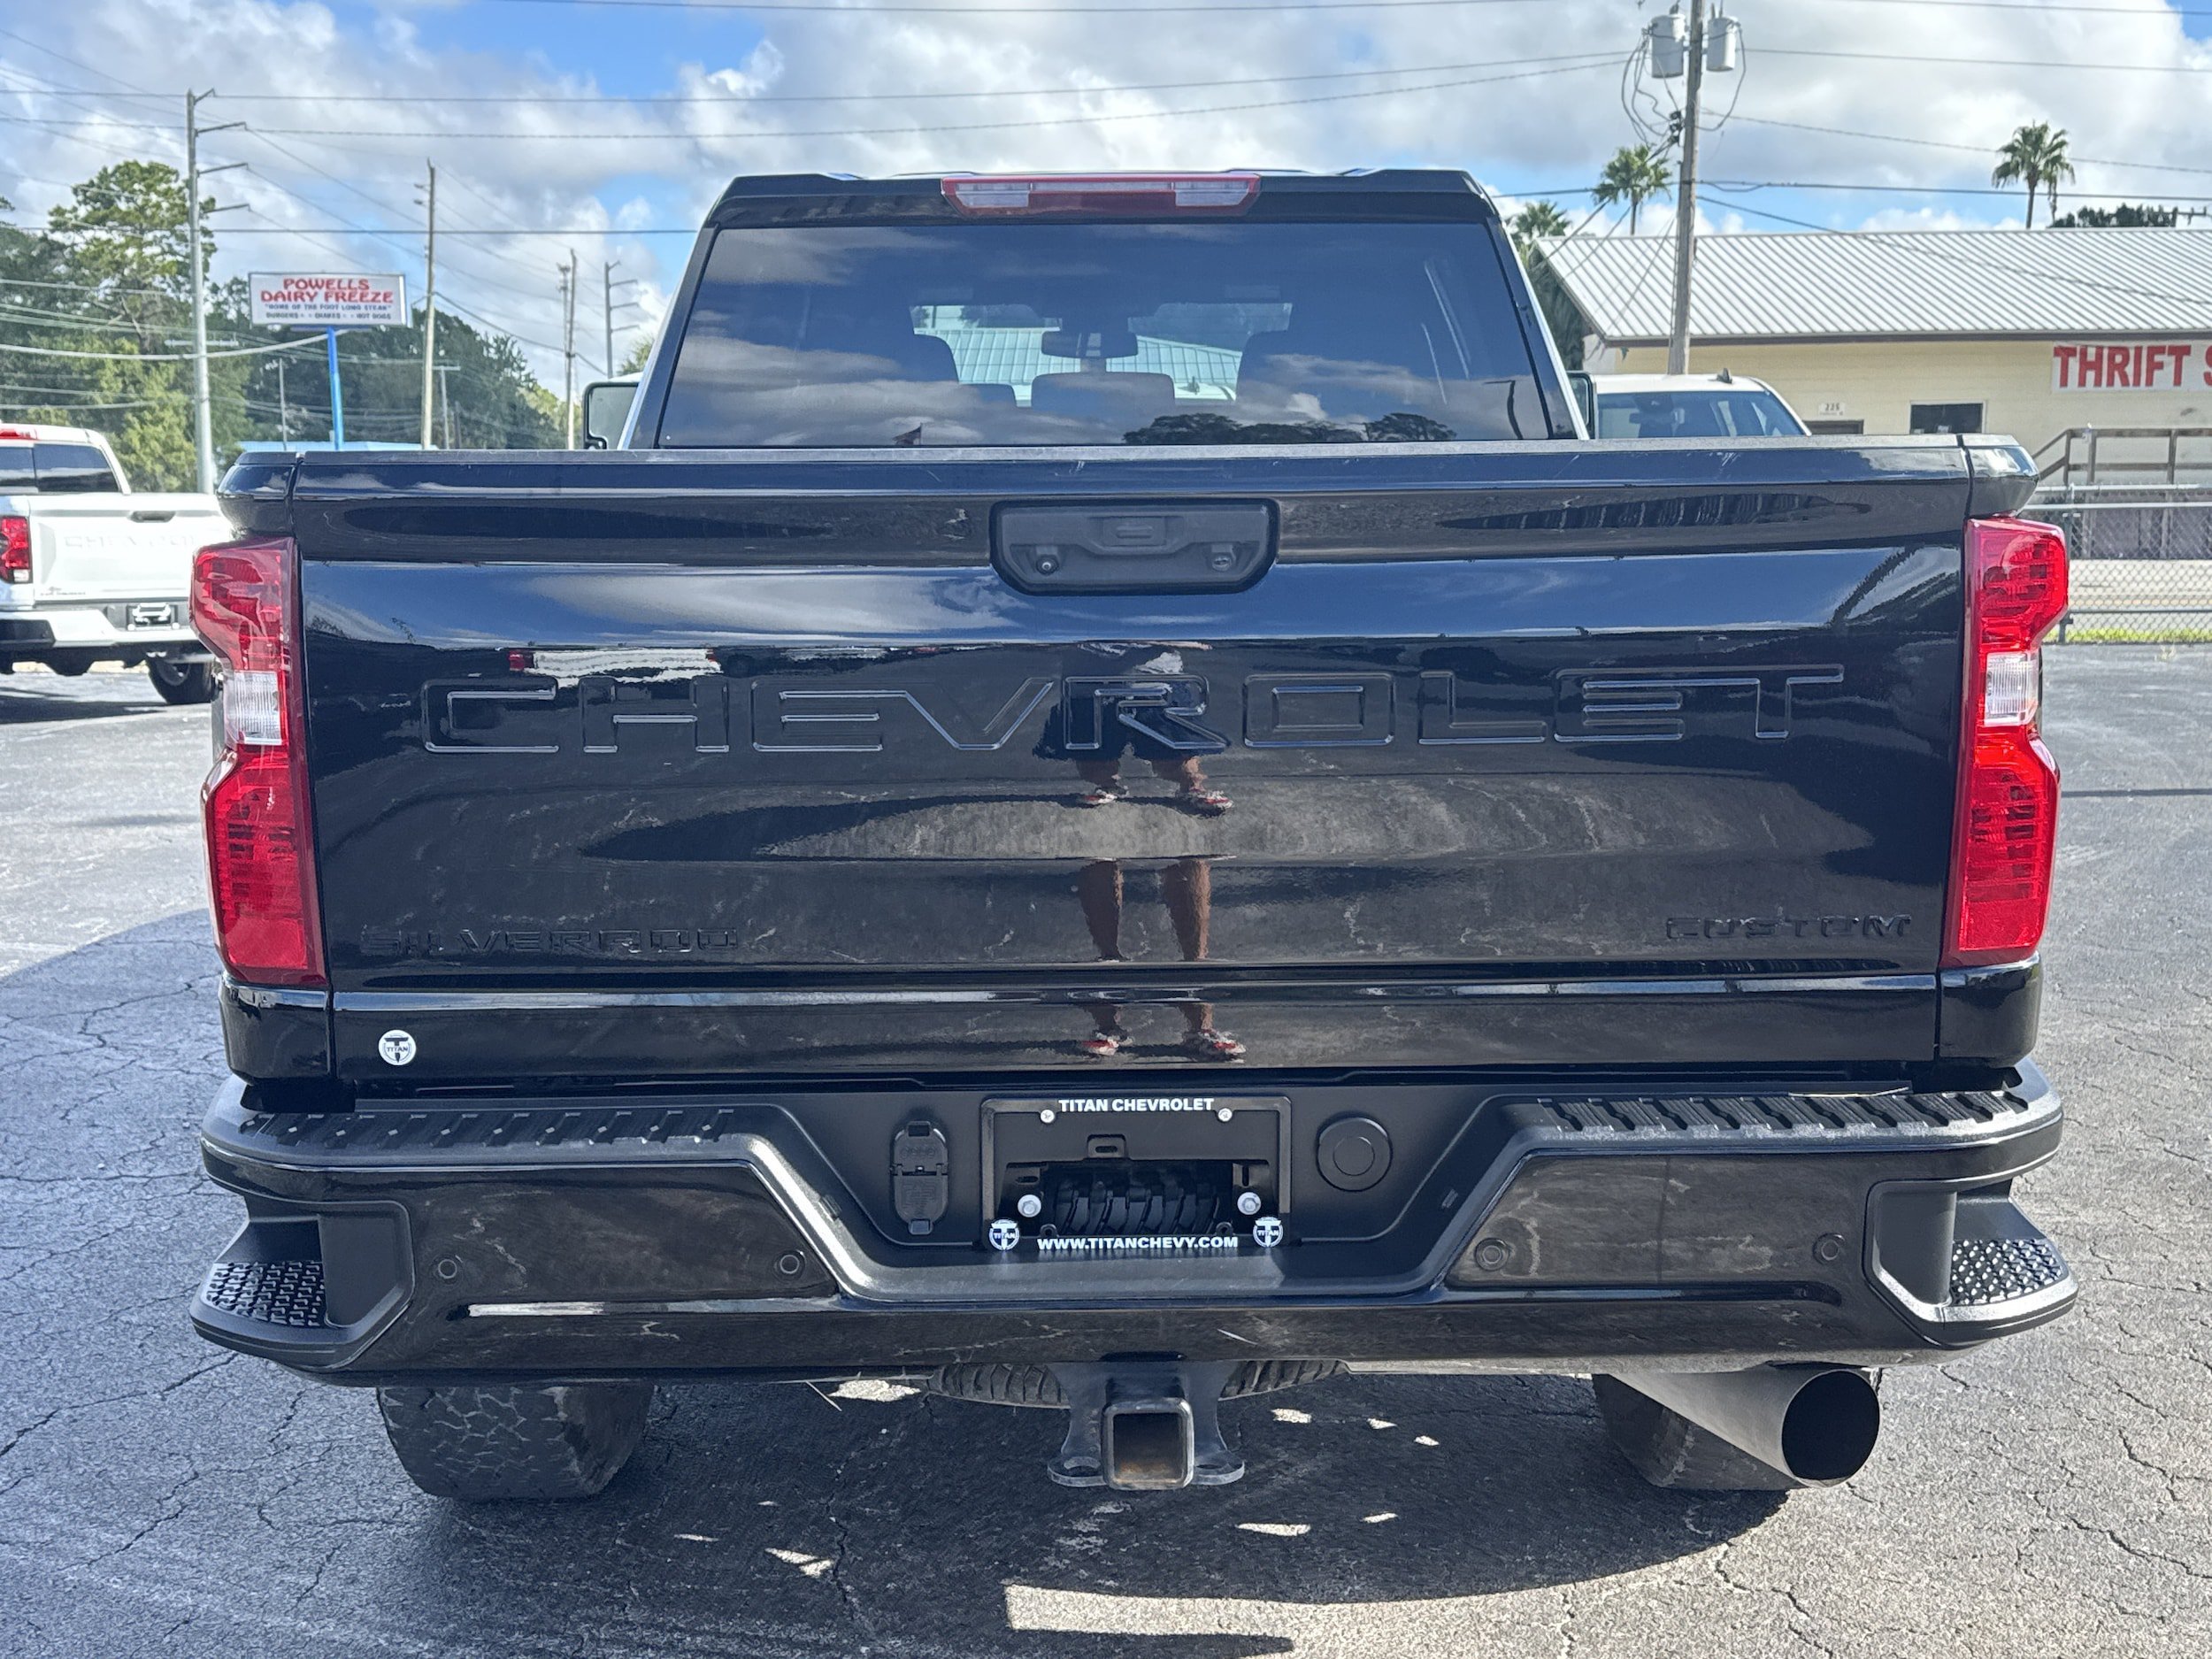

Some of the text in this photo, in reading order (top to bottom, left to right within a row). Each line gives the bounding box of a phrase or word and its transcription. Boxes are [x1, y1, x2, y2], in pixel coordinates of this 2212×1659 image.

[283, 277, 370, 290] POWELLS
[260, 290, 394, 303] DAIRY FREEZE
[2053, 344, 2193, 388] THRIFT
[420, 664, 1846, 755] CHEVROLET
[1665, 914, 1912, 939] CUSTOM
[359, 926, 739, 956] SILVERADO
[1058, 1097, 1215, 1113] TITAN CHEVROLET
[1036, 1236, 1239, 1250] WWW.TITANCHEVY.COM
